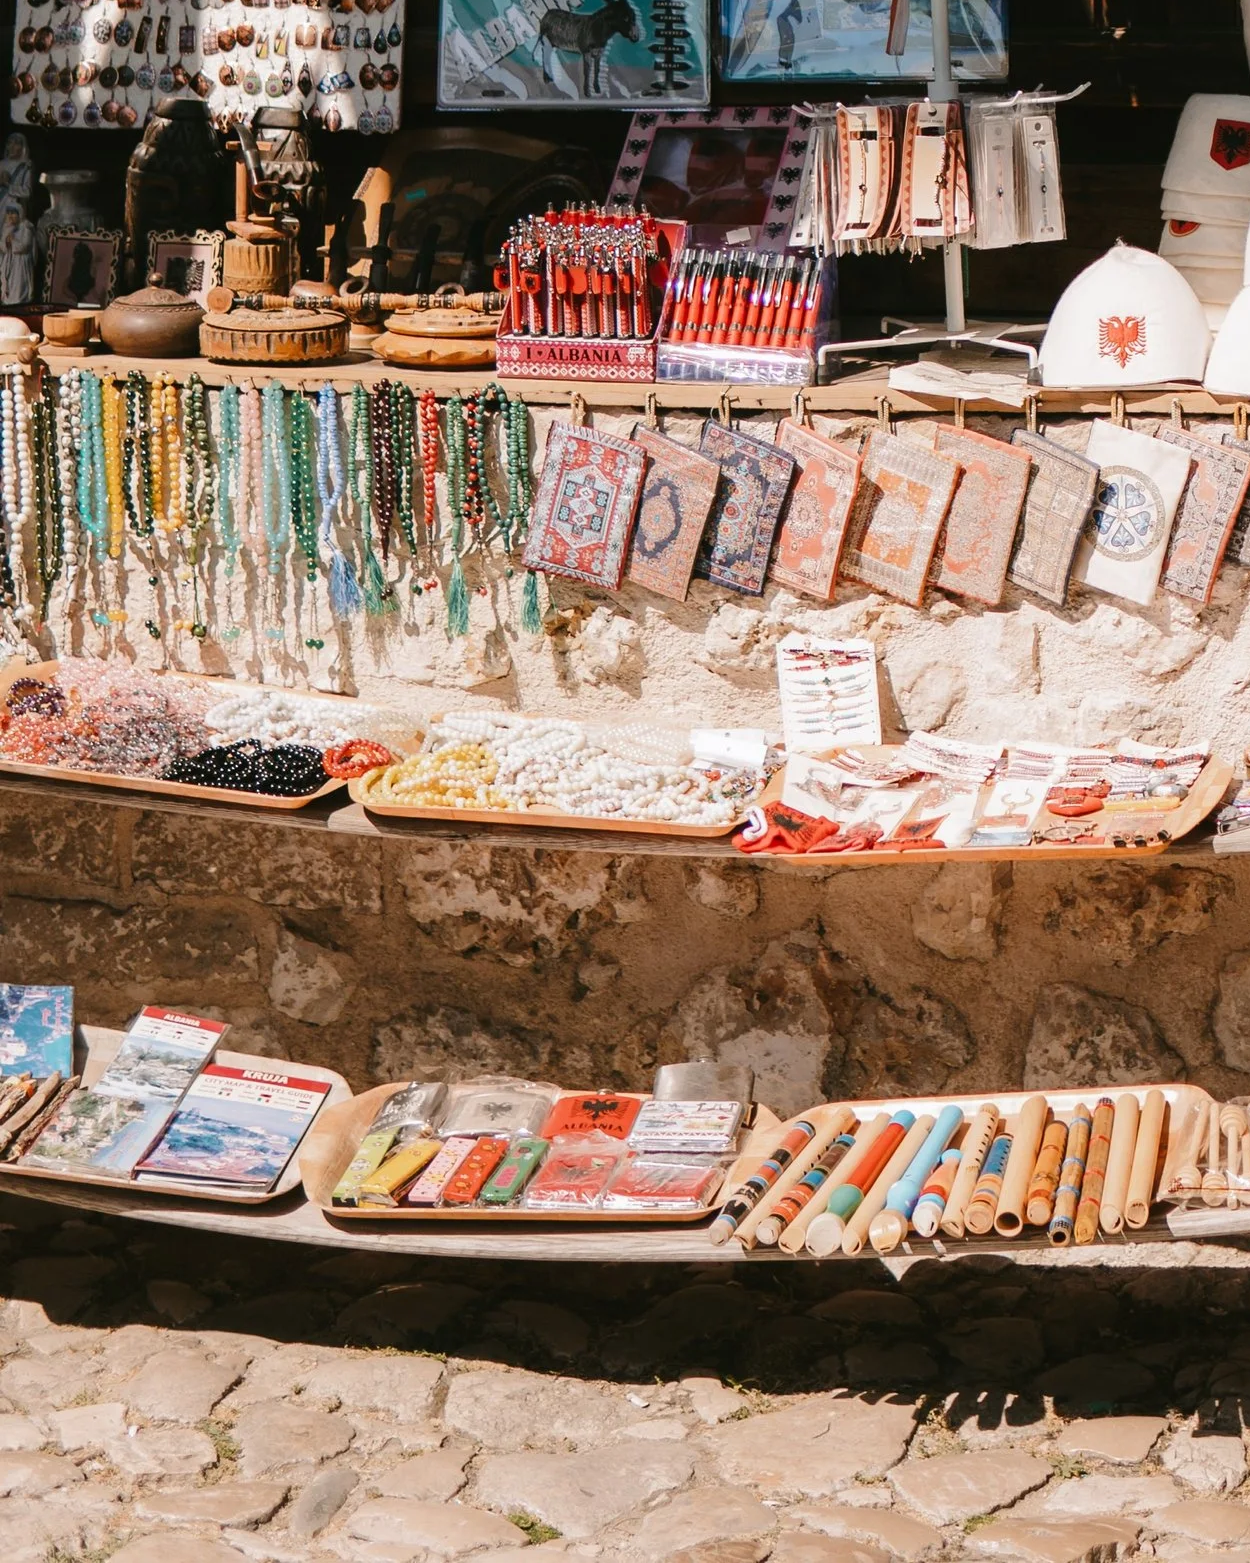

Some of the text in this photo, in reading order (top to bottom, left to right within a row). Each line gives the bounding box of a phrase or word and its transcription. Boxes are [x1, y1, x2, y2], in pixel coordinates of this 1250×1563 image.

[526, 347, 622, 363] I ALBANIA
[163, 1014, 201, 1027] ALBANIA
[242, 1069, 289, 1085] KRUJA
[204, 1077, 223, 1085] CITY
[224, 1079, 246, 1088] MAP
[255, 1085, 286, 1095] TRAVEL
[287, 1089, 316, 1100] GUIDE
[560, 1122, 624, 1133] ALBANIA
